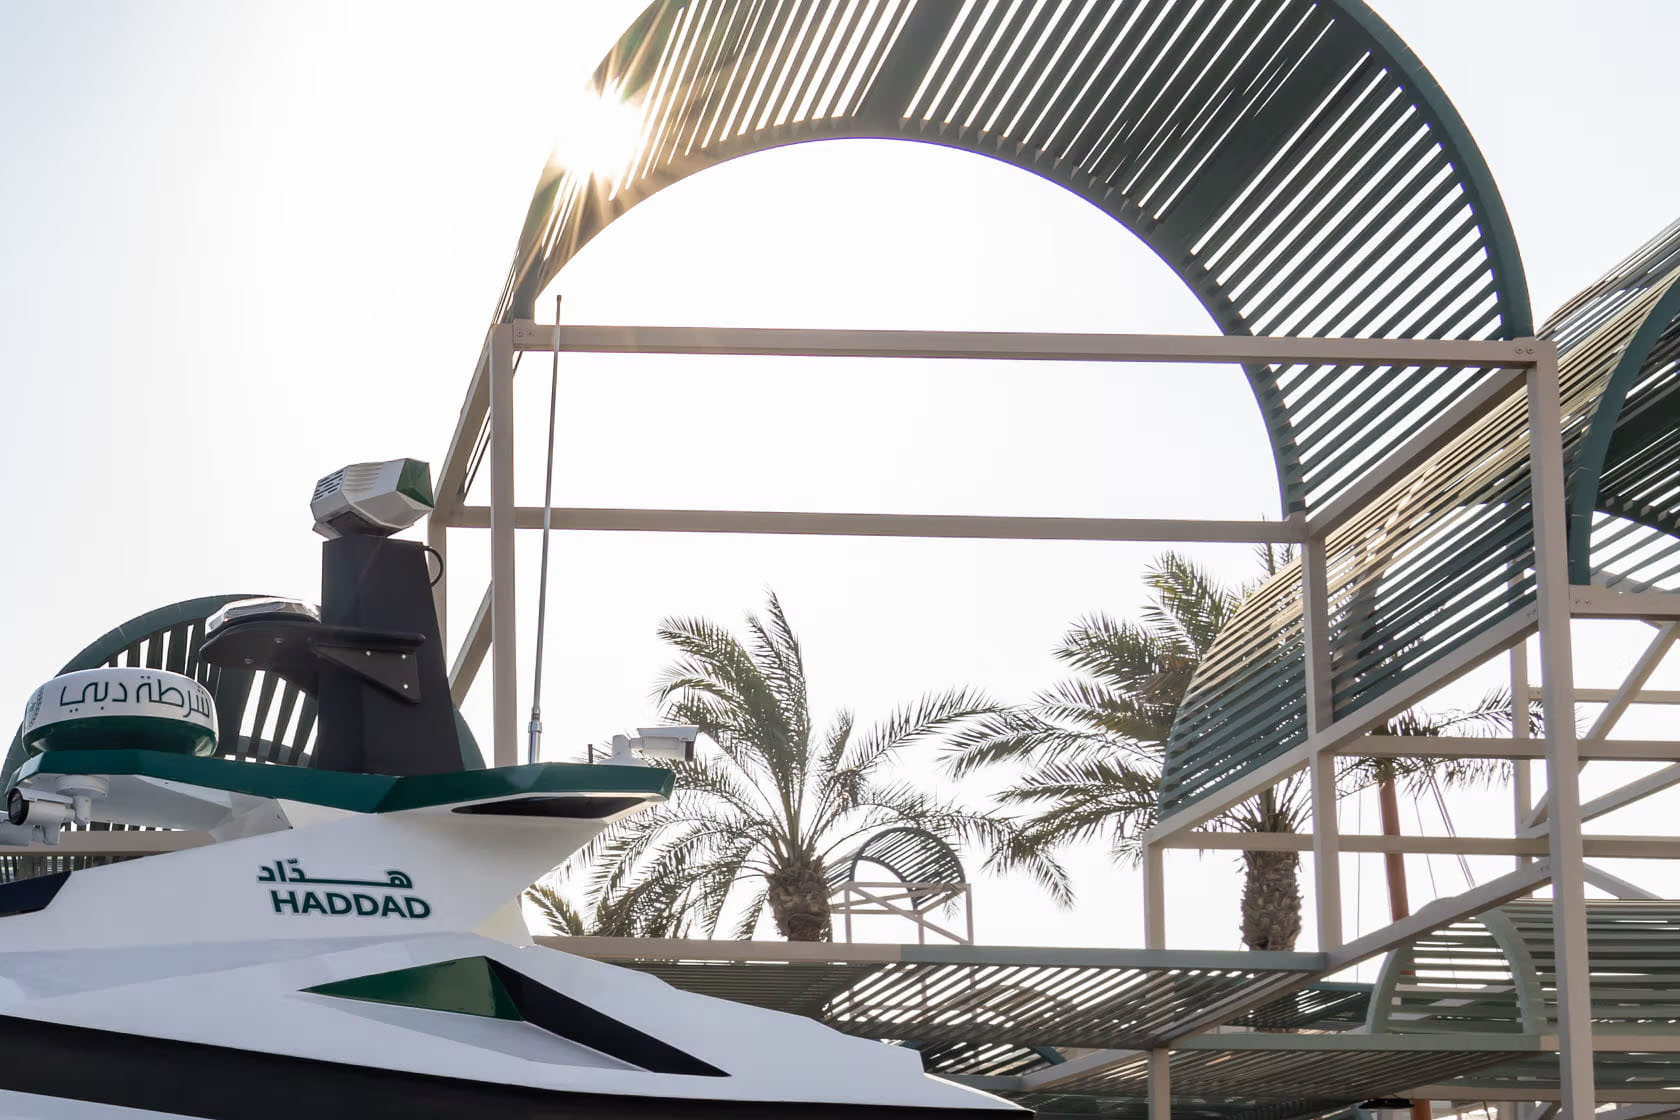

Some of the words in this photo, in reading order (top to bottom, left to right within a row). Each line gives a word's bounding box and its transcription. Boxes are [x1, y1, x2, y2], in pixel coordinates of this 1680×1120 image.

[59, 681, 128, 714] دبي
[136, 675, 210, 719] شرطة
[270, 890, 431, 919] HADDAD
